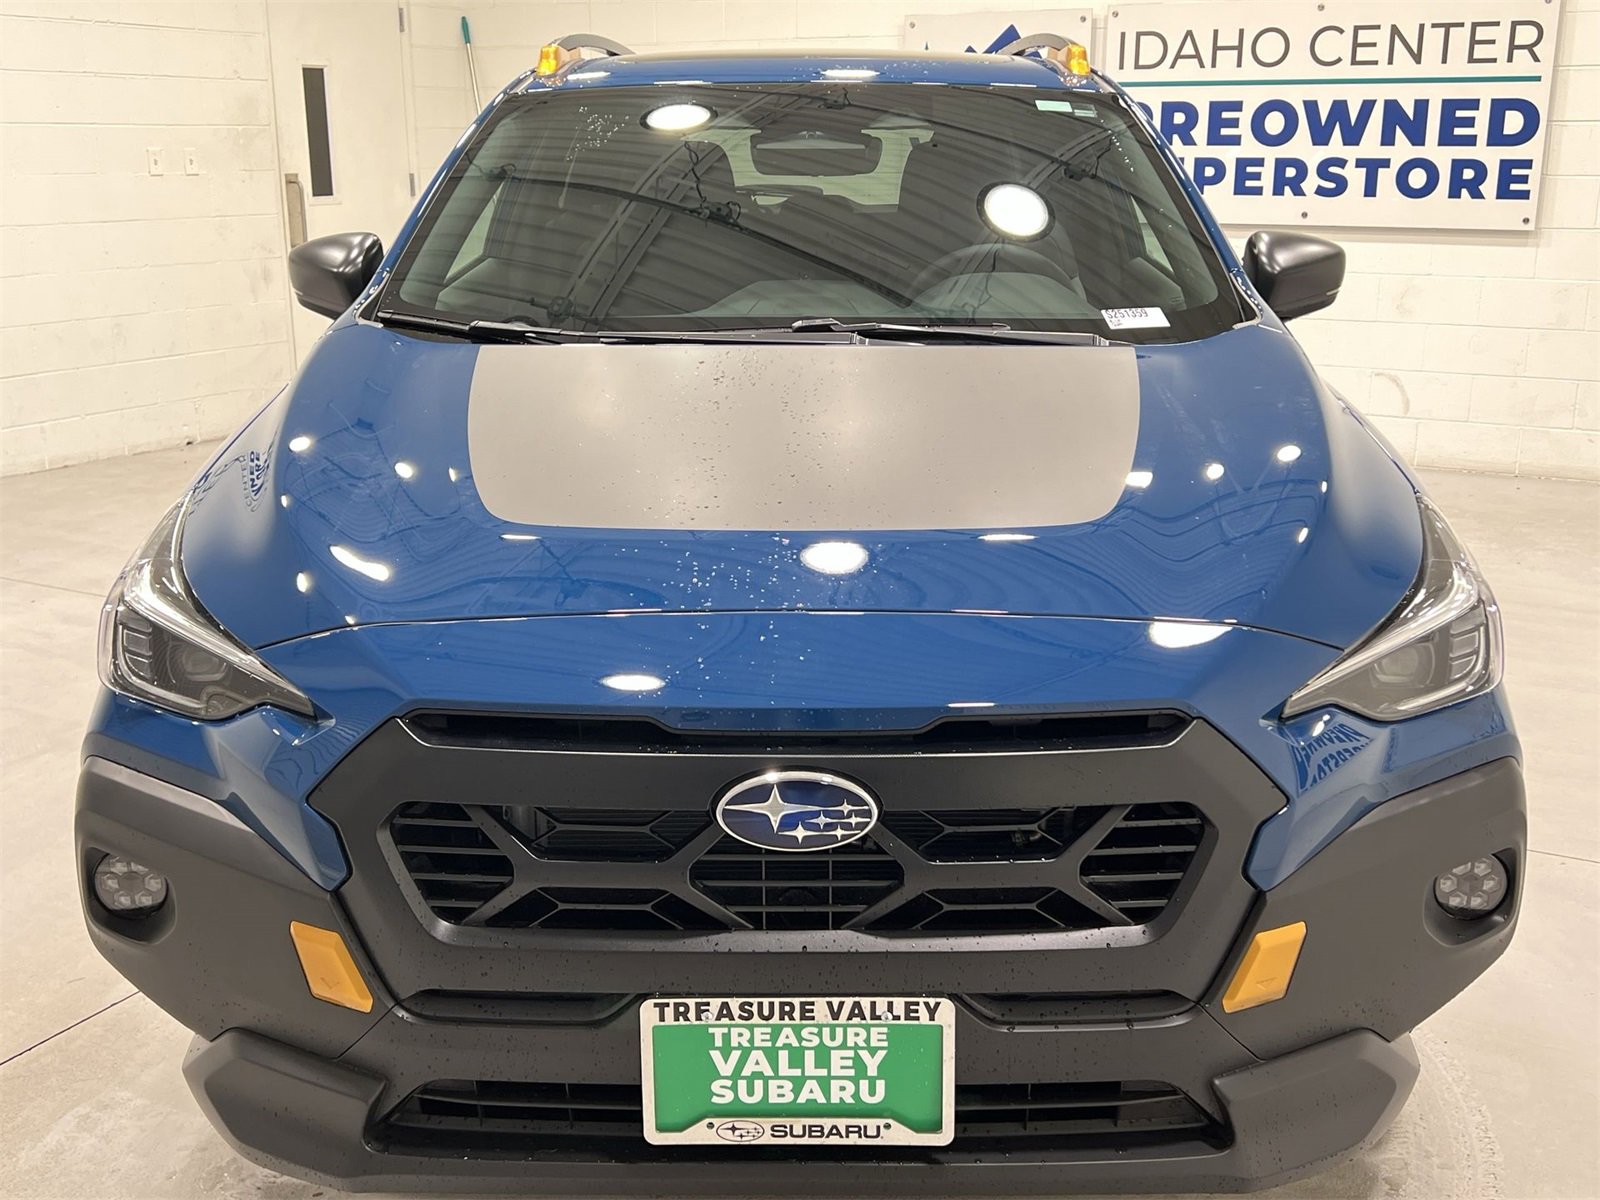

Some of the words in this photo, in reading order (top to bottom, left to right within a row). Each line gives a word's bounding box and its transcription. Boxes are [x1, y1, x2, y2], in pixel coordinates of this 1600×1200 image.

[1118, 26, 1290, 70] IDAHO
[1309, 20, 1544, 66] CENTER
[1136, 98, 1541, 147] REOWNED
[1178, 157, 1532, 200] PERSTORE
[653, 1001, 815, 1022] TREASURE
[827, 1001, 941, 1022] VALLEY
[708, 1027, 888, 1047] TREASURE
[708, 1050, 887, 1077] VALLEY
[710, 1079, 886, 1104] SUBARU
[770, 1124, 881, 1139] SUBARU
